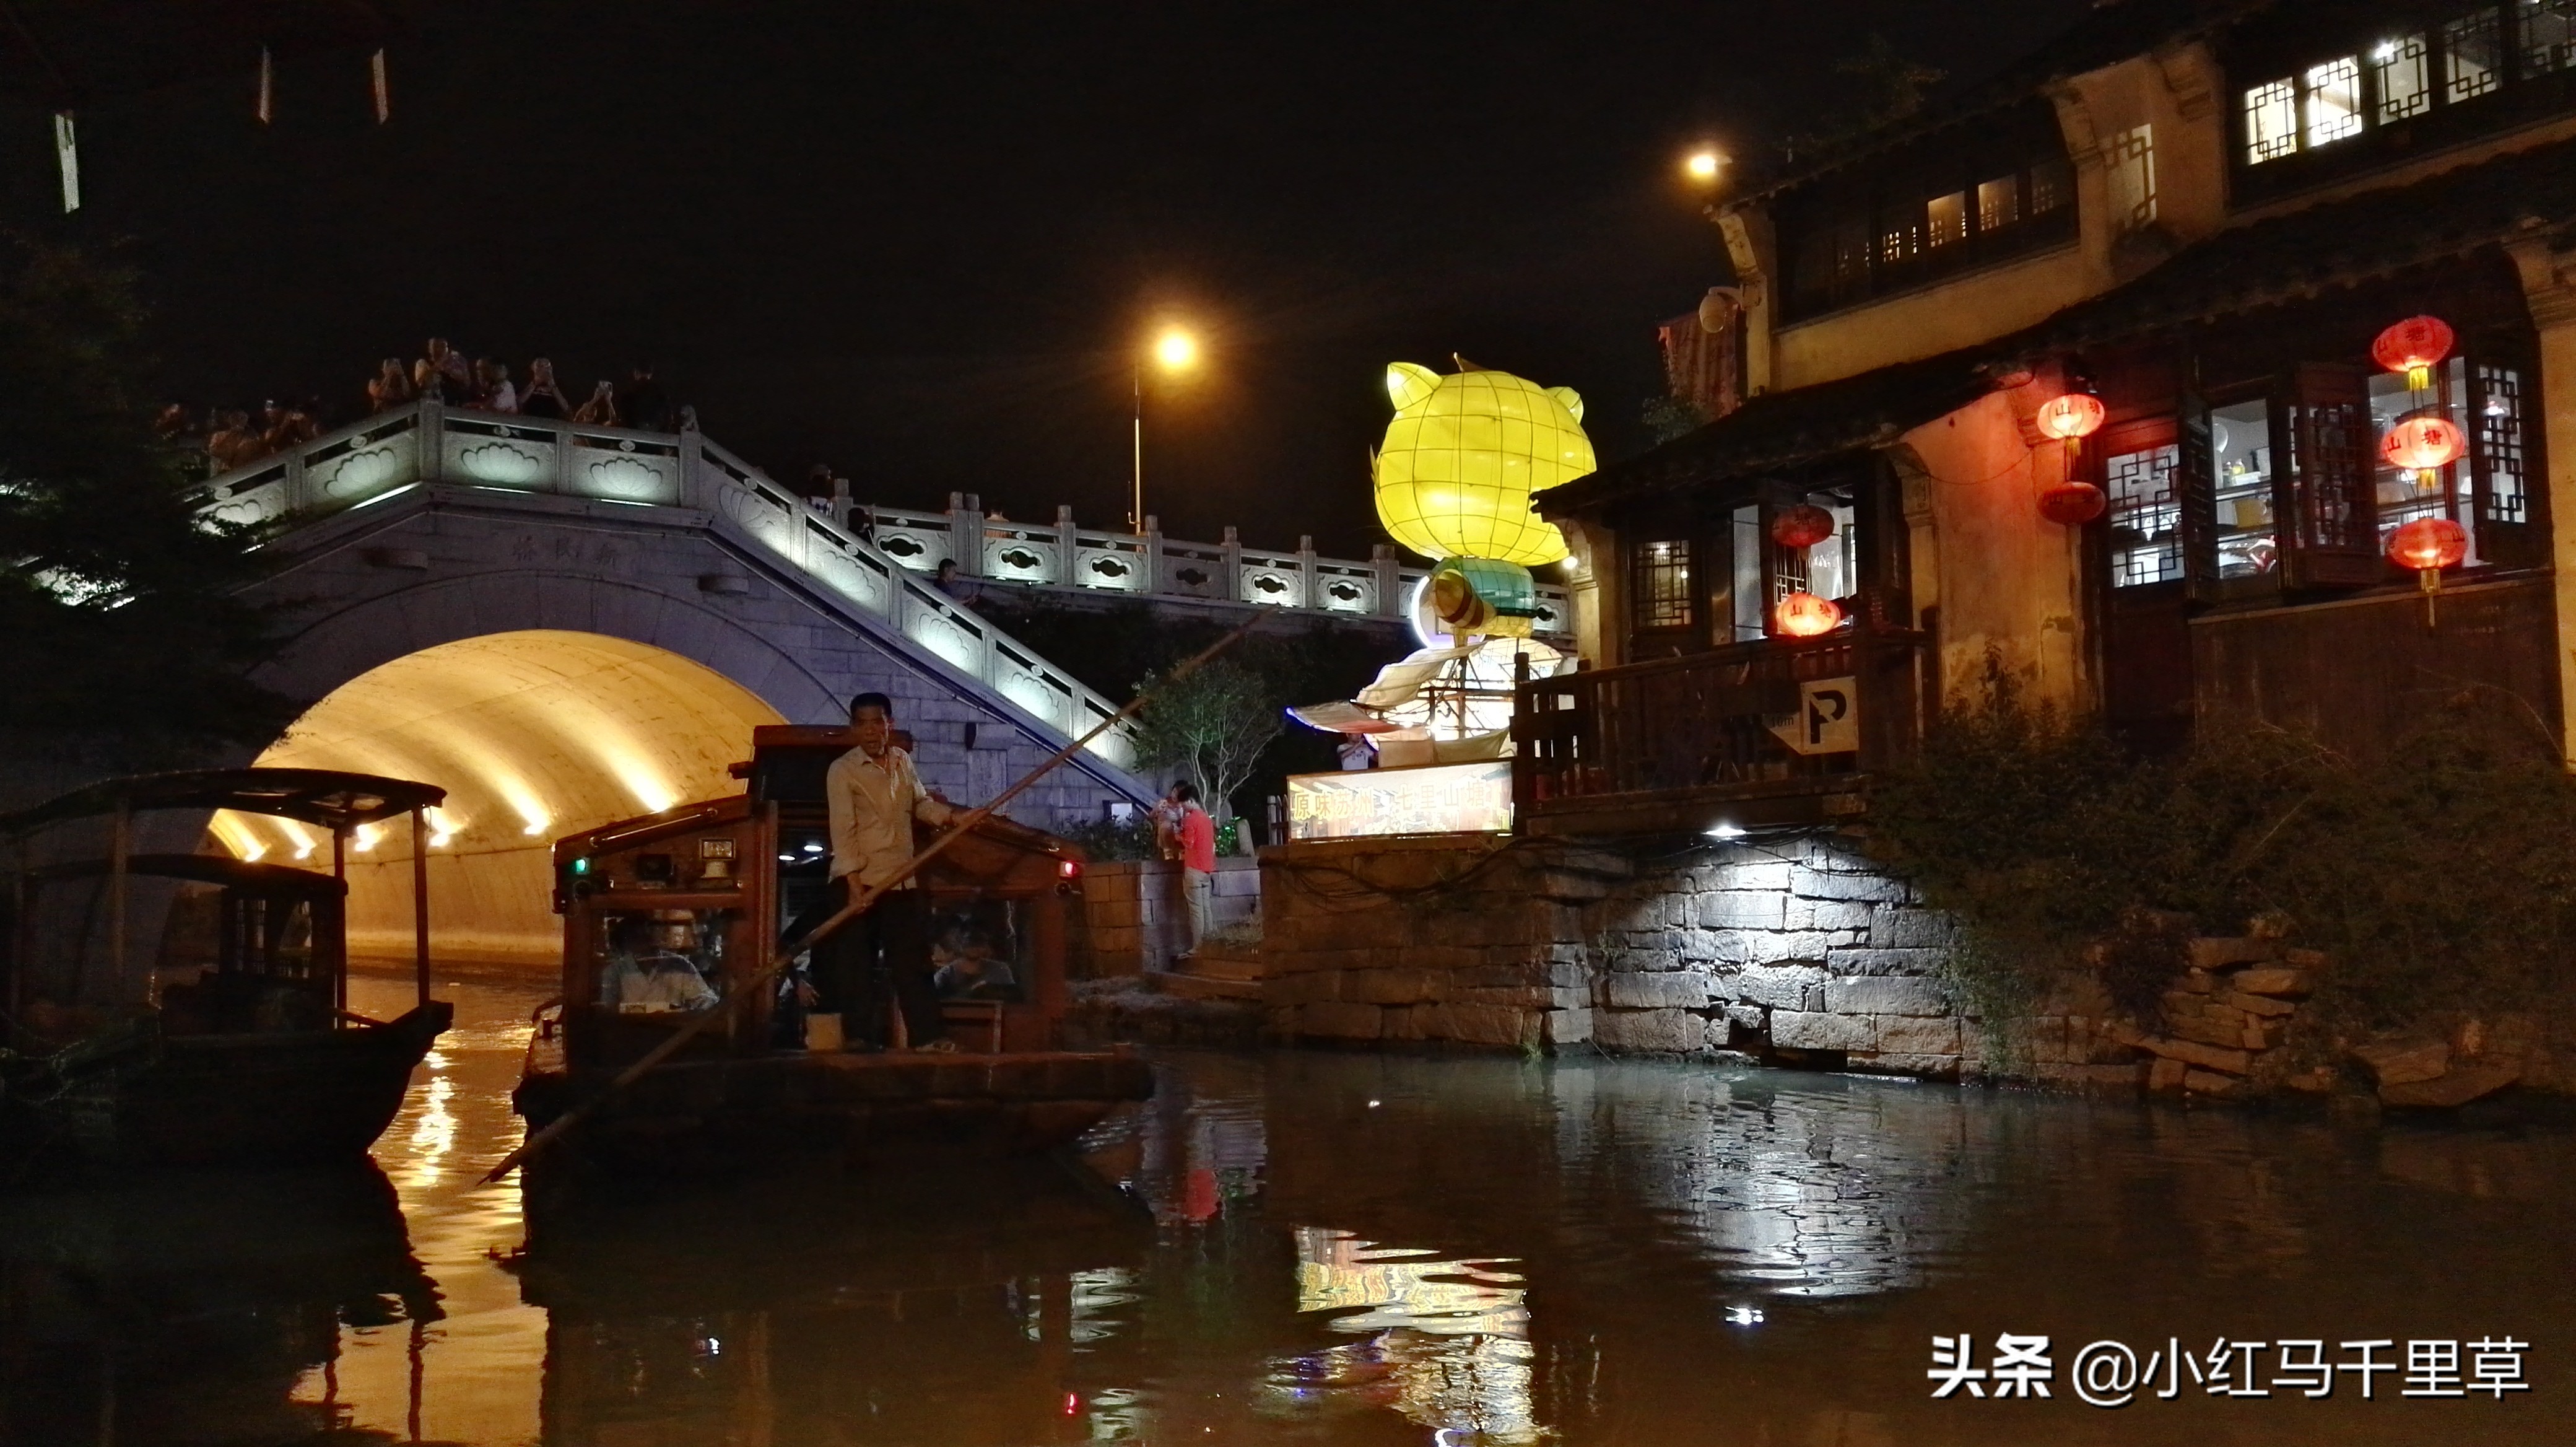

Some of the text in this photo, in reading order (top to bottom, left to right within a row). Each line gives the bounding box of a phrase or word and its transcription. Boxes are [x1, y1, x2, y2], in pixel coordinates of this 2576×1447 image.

[1294, 779, 1486, 820] 原味苏州 七里山塘
